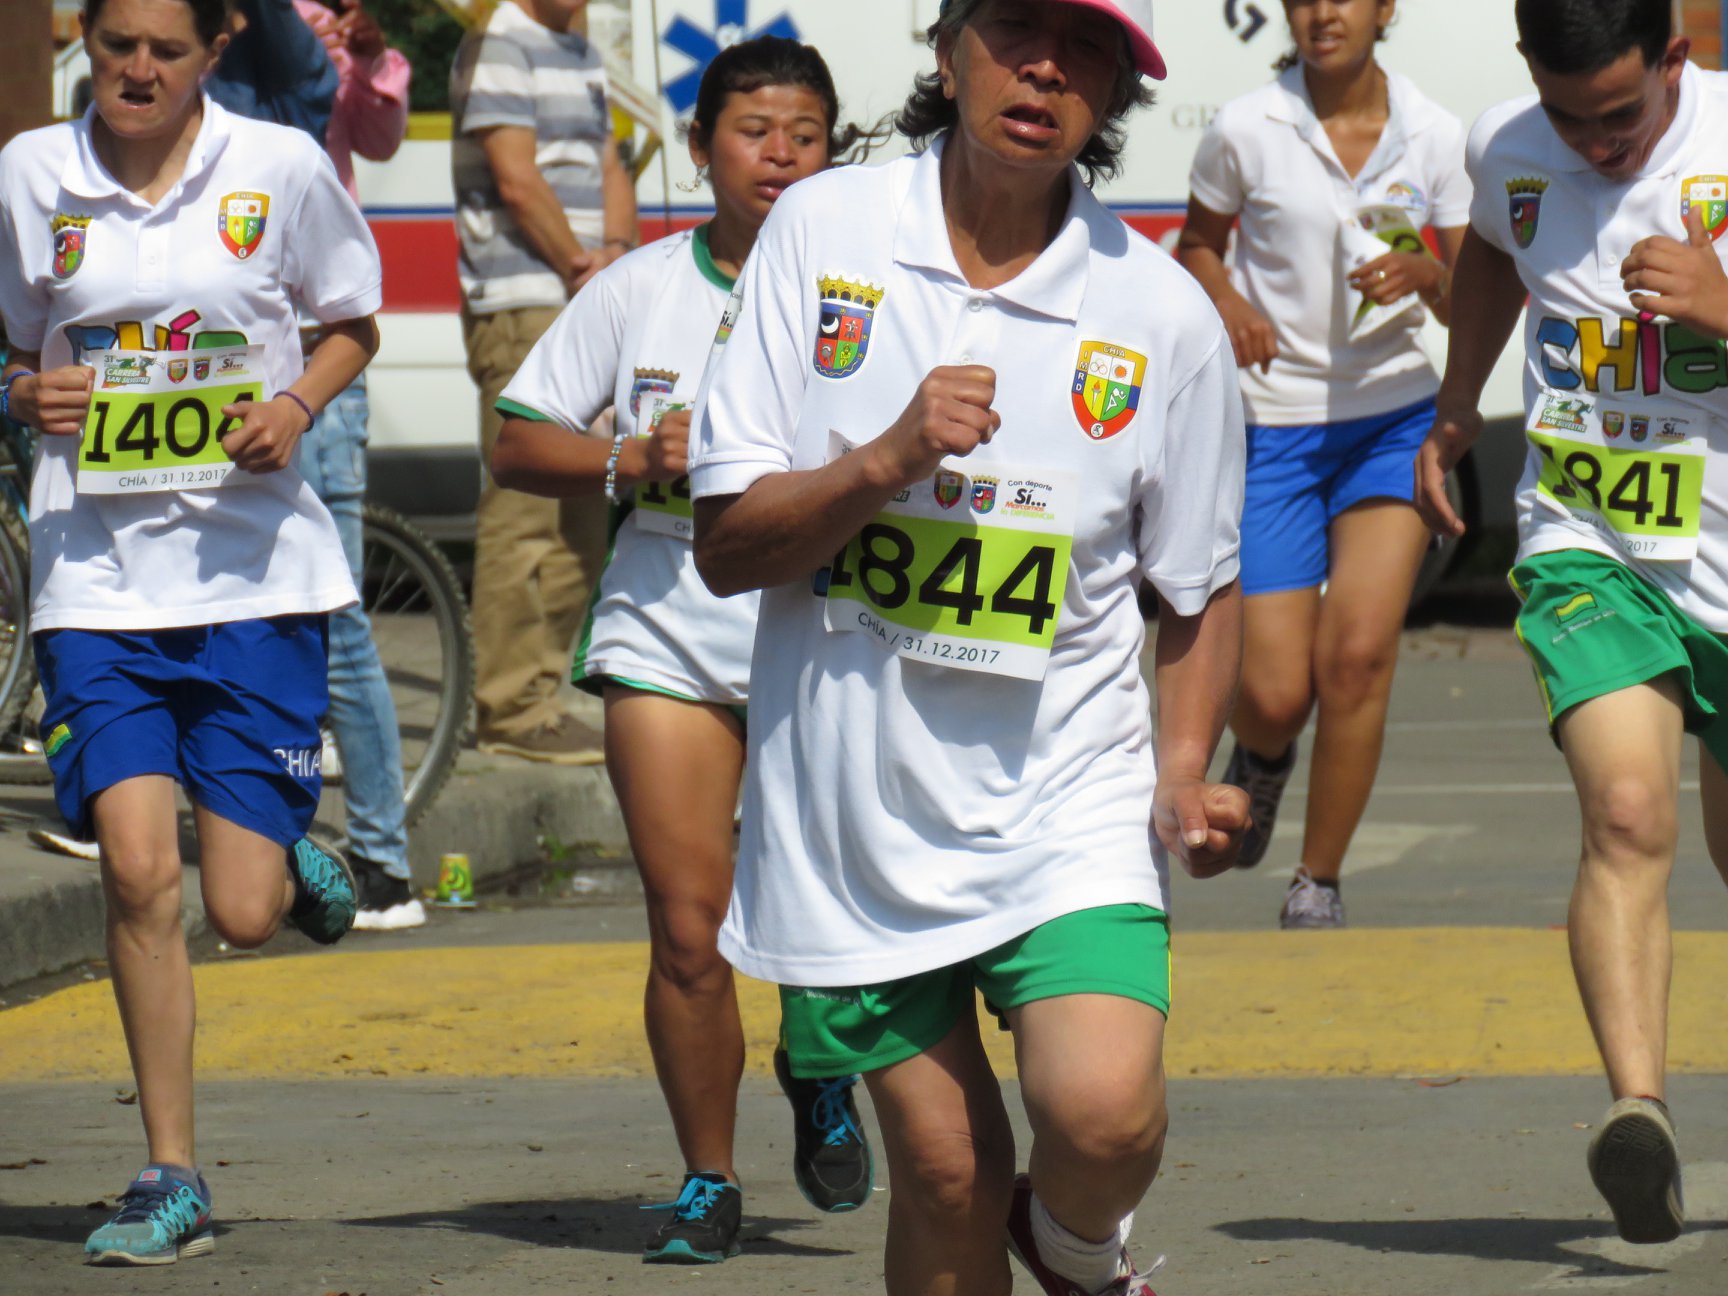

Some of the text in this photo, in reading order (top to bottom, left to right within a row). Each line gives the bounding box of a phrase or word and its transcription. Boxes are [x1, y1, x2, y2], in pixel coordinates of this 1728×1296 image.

[118, 477, 147, 487] CHÍA
[160, 469, 227, 484] 31.12.2017
[1025, 480, 1053, 491] deporte
[1014, 487, 1047, 506] Sí...
[857, 611, 887, 641] CHÍA
[903, 635, 1001, 664] 31.12.2017
